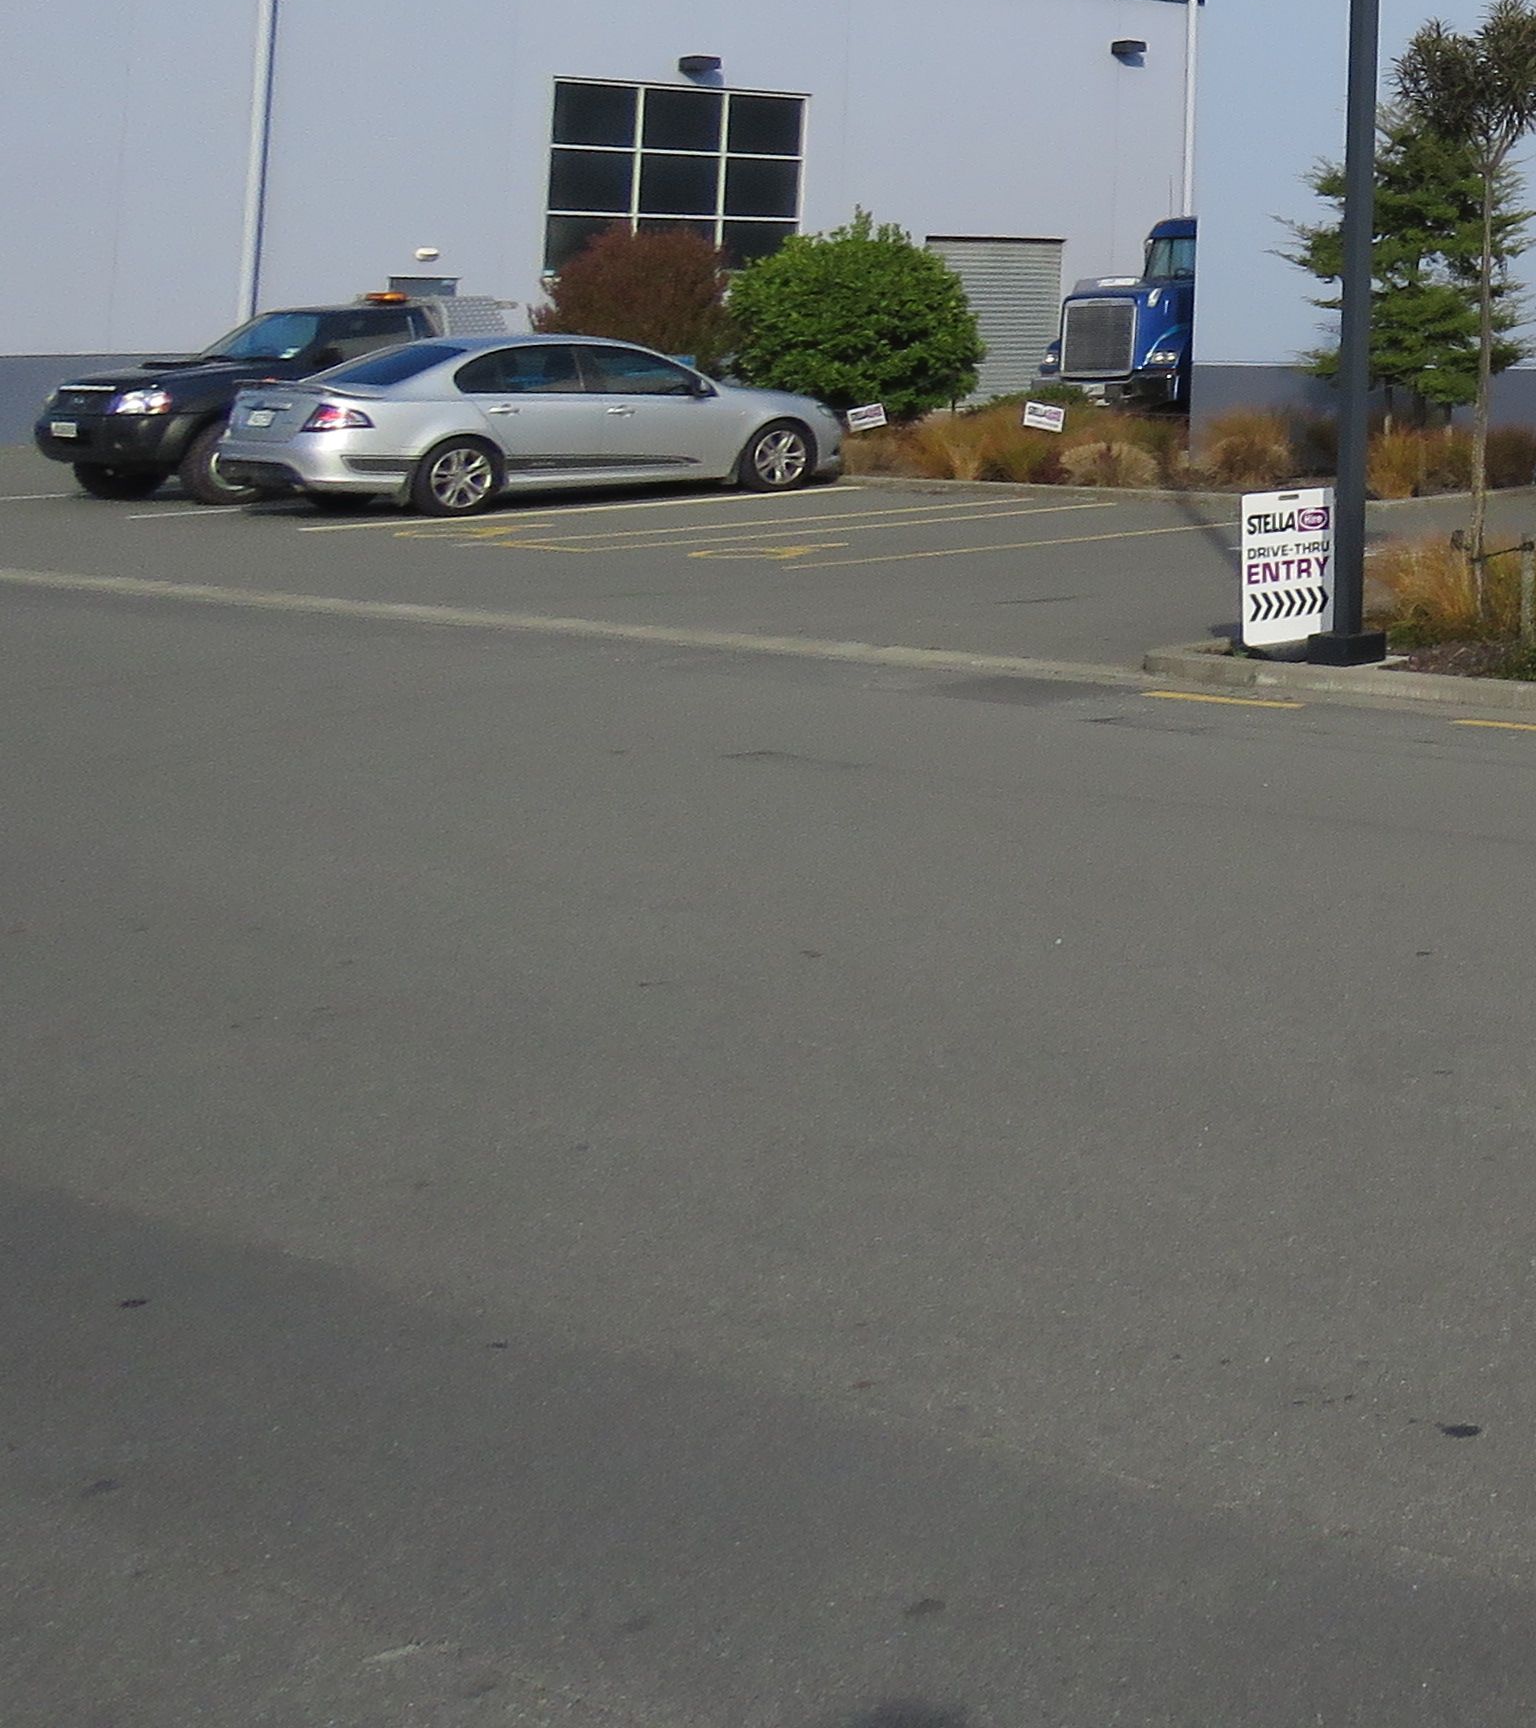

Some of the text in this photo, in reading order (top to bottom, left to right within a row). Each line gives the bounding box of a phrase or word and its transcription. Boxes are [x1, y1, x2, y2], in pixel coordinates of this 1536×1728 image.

[1246, 511, 1298, 536] STELLA
[1247, 540, 1330, 561] DRIVE-THRU
[1246, 556, 1330, 586] ENTRY
